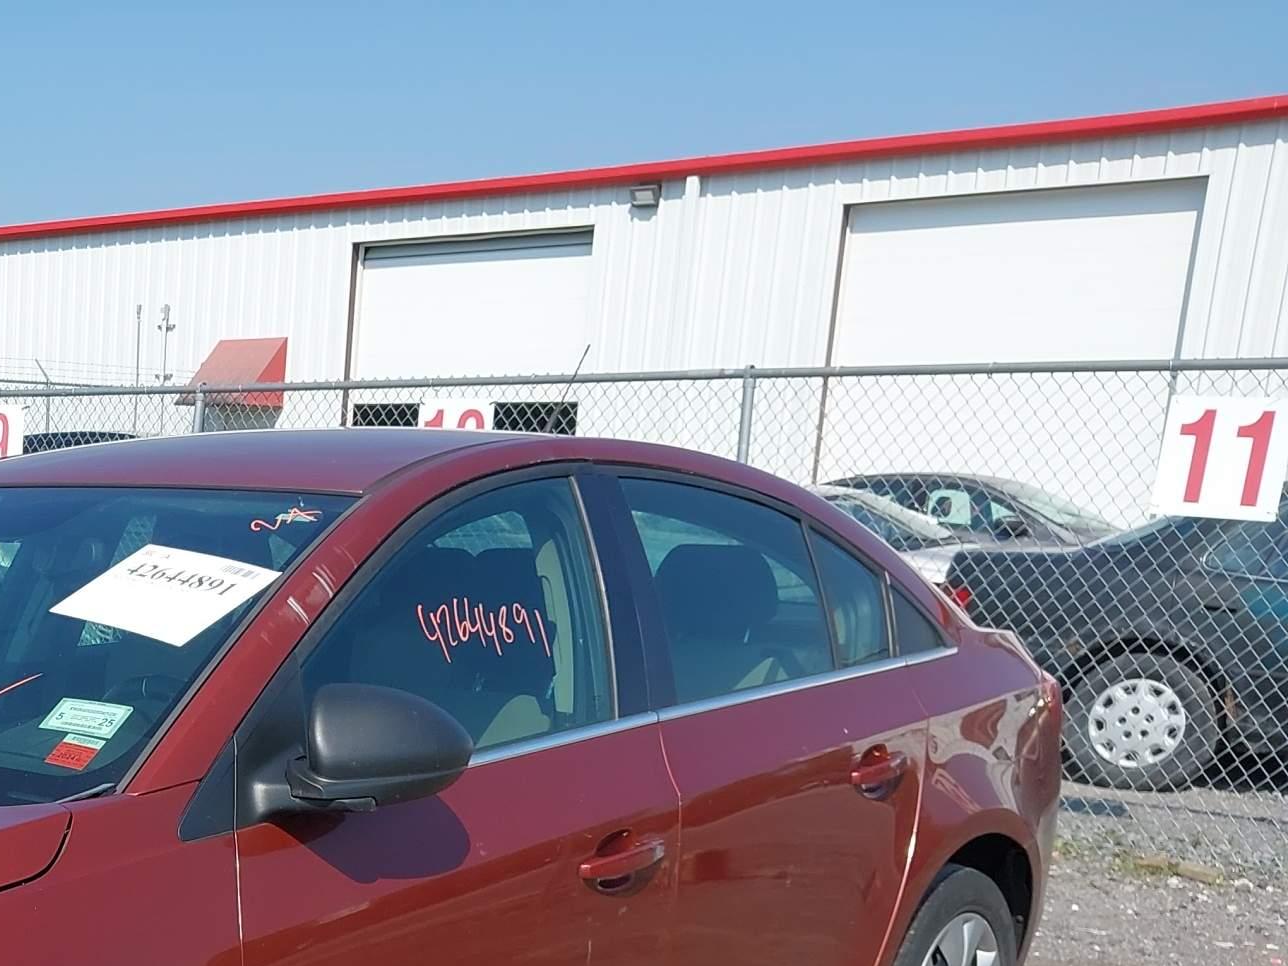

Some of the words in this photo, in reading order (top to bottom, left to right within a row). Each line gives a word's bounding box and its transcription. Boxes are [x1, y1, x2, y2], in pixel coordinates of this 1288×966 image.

[1179, 408, 1277, 507] 11
[127, 562, 237, 596] 42644891
[417, 597, 551, 664] 42644891
[55, 712, 66, 720] 5
[98, 717, 116, 728] 25
